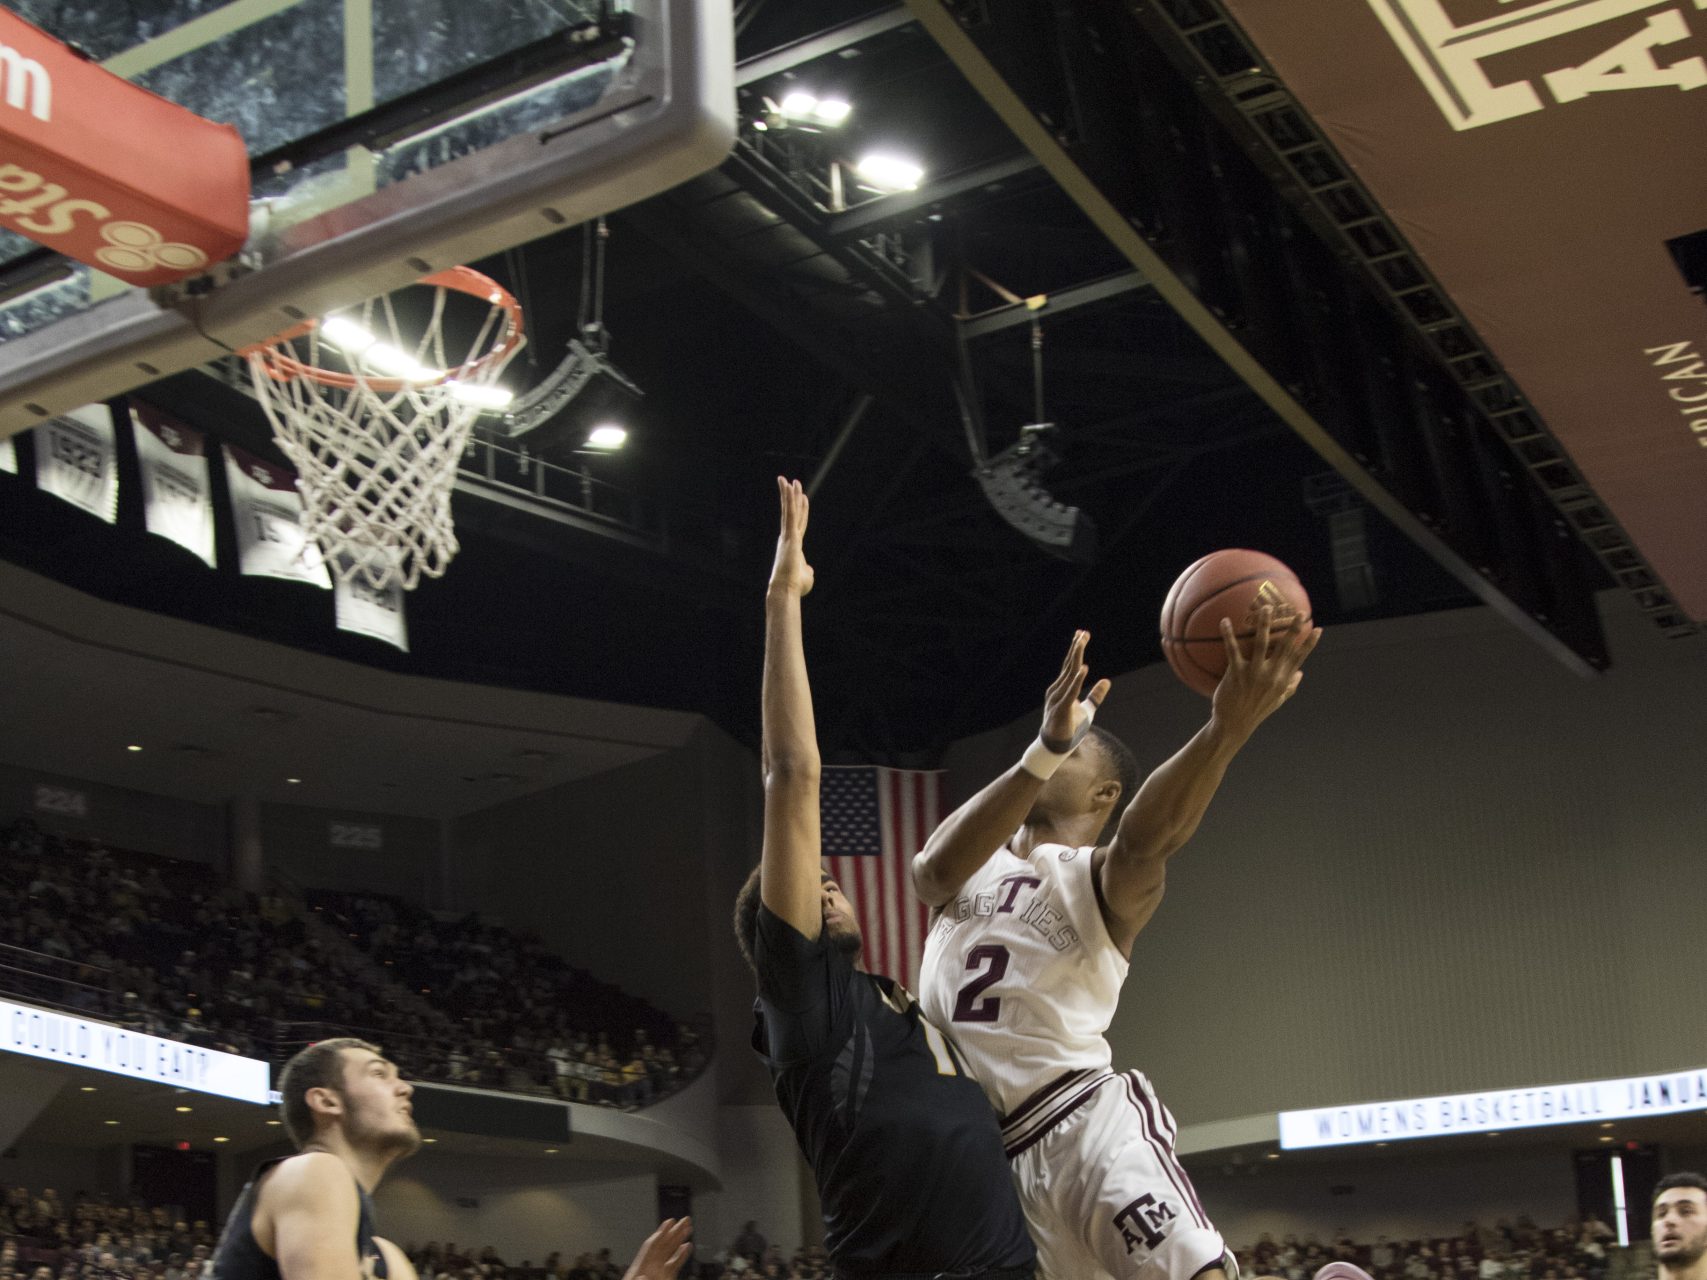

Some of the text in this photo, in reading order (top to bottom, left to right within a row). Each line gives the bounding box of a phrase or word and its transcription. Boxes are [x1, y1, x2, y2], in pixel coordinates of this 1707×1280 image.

[952, 945, 1011, 1022] 2
[1314, 1103, 1427, 1139] WOMENS
[1441, 1084, 1605, 1129] BASKETBALL
